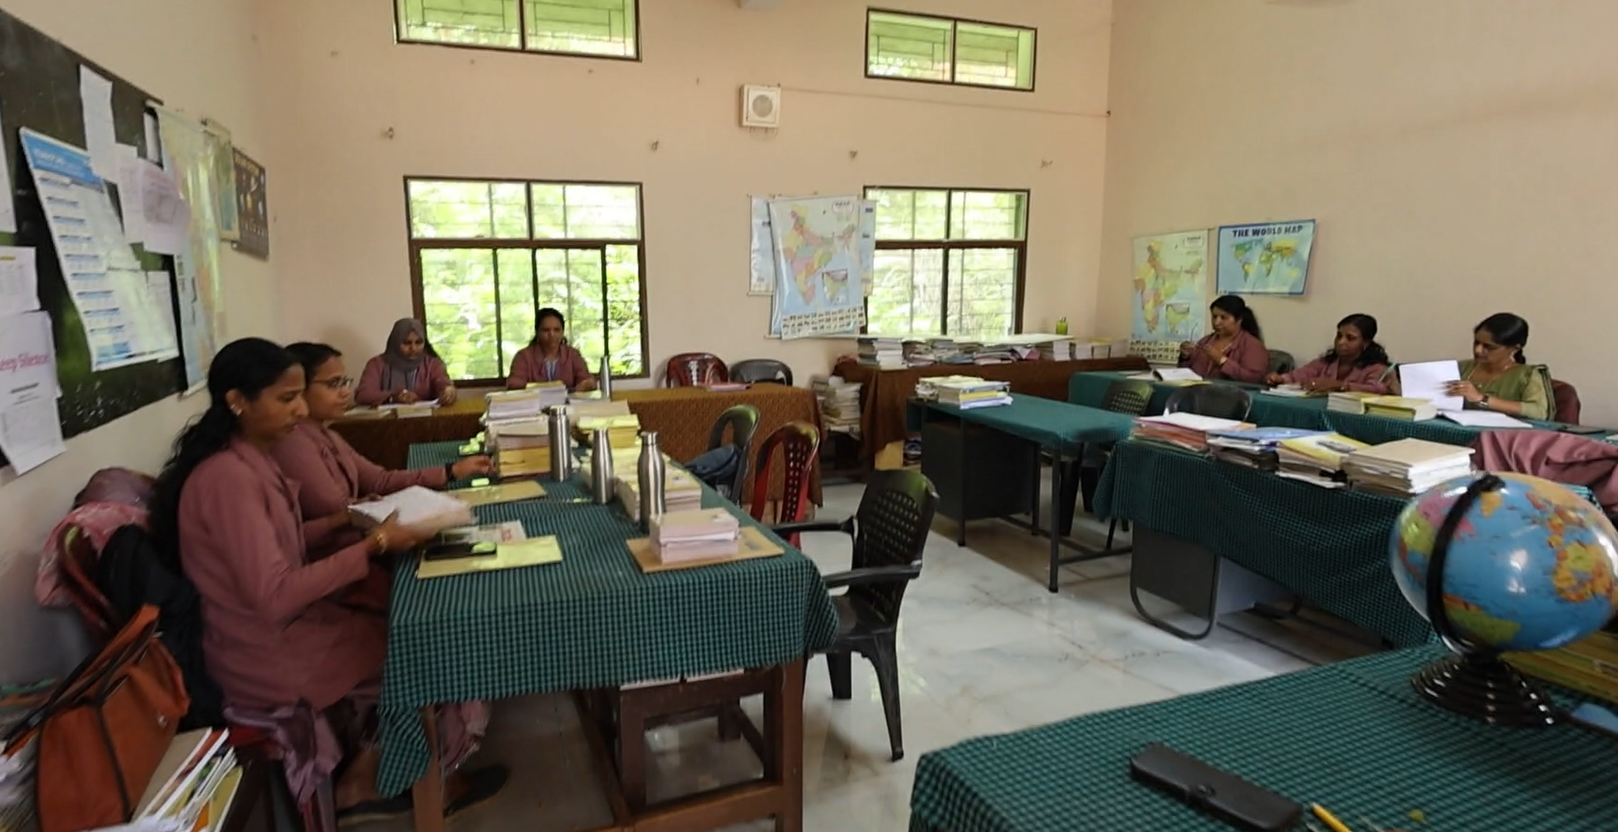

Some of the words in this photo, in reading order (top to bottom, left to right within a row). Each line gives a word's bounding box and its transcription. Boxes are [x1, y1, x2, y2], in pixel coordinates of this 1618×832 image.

[1232, 229, 1249, 238] THE
[1252, 227, 1283, 237] WORLD
[1284, 225, 1303, 235] MAP
